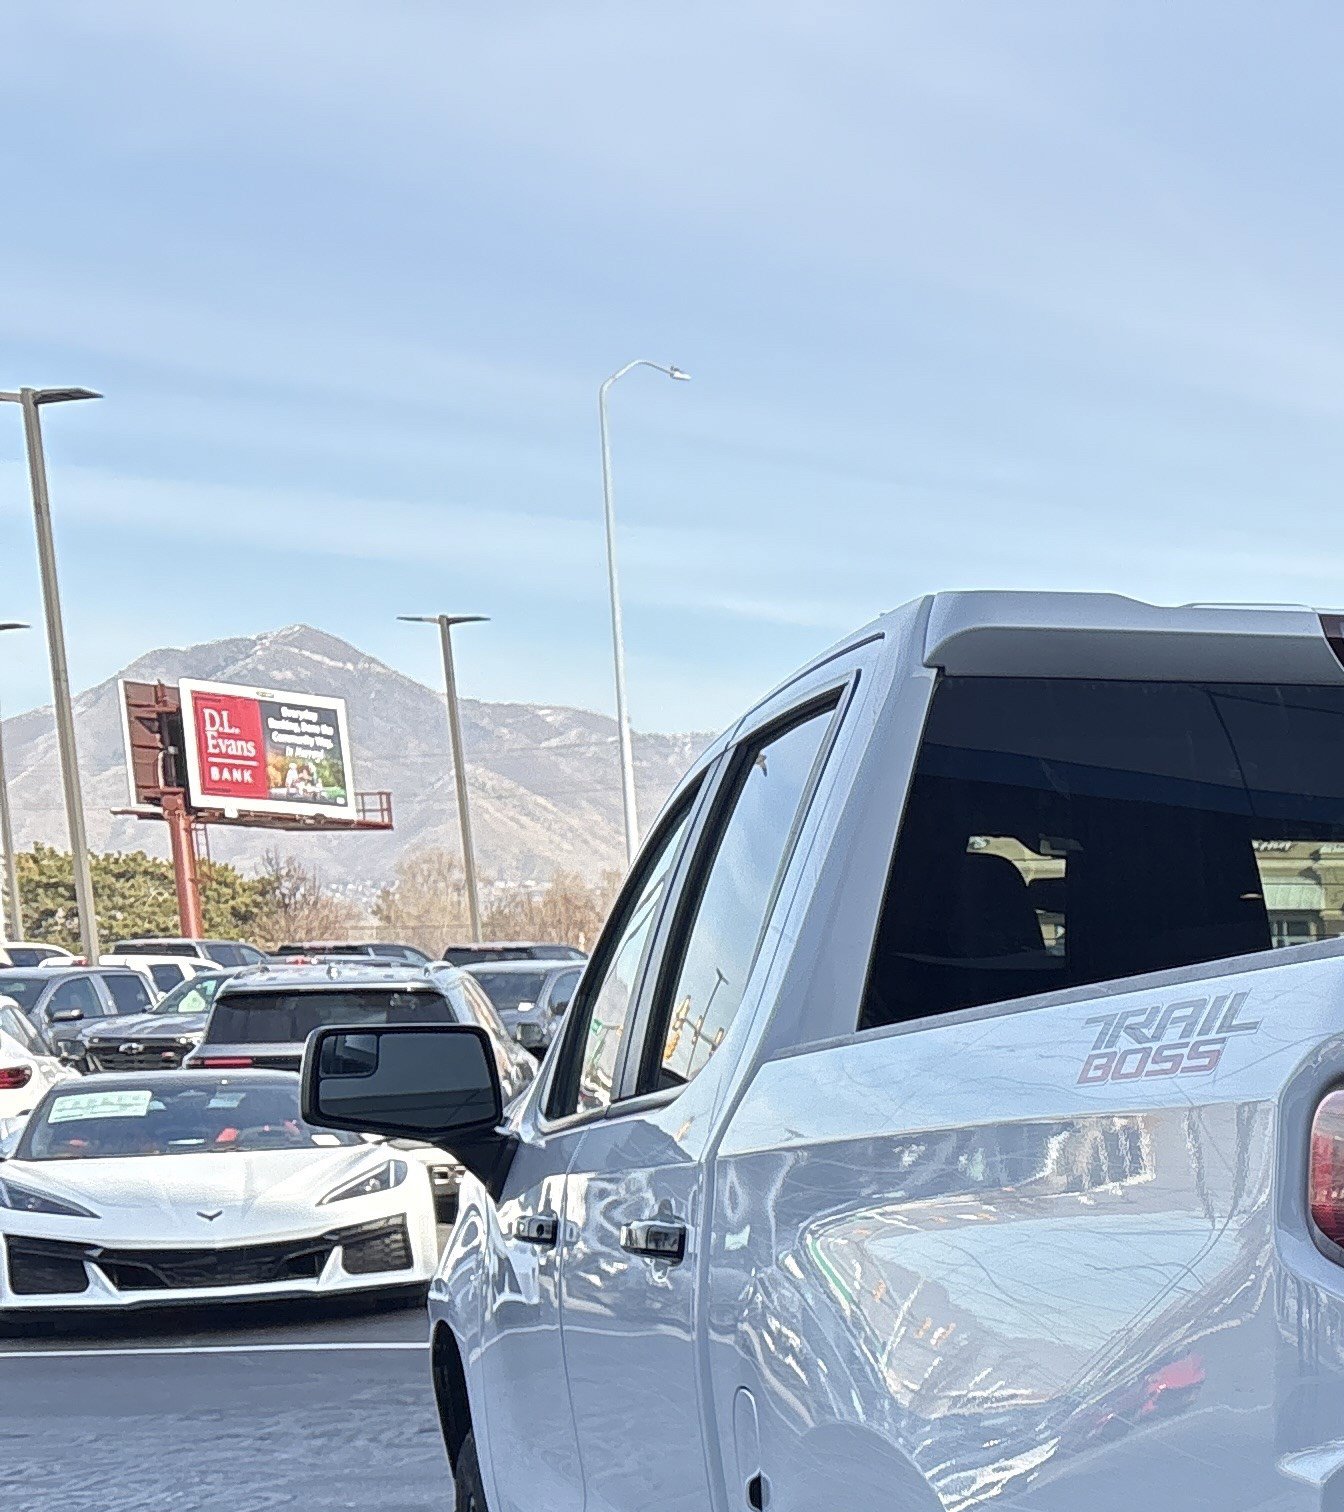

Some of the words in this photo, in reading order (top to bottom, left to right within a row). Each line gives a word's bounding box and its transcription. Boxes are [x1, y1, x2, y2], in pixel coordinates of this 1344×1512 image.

[203, 708, 241, 735] D.L.
[206, 730, 256, 757] Evans
[210, 766, 253, 783] BANK
[1083, 988, 1263, 1051] TRAIL
[1075, 1037, 1228, 1087] BOSS
